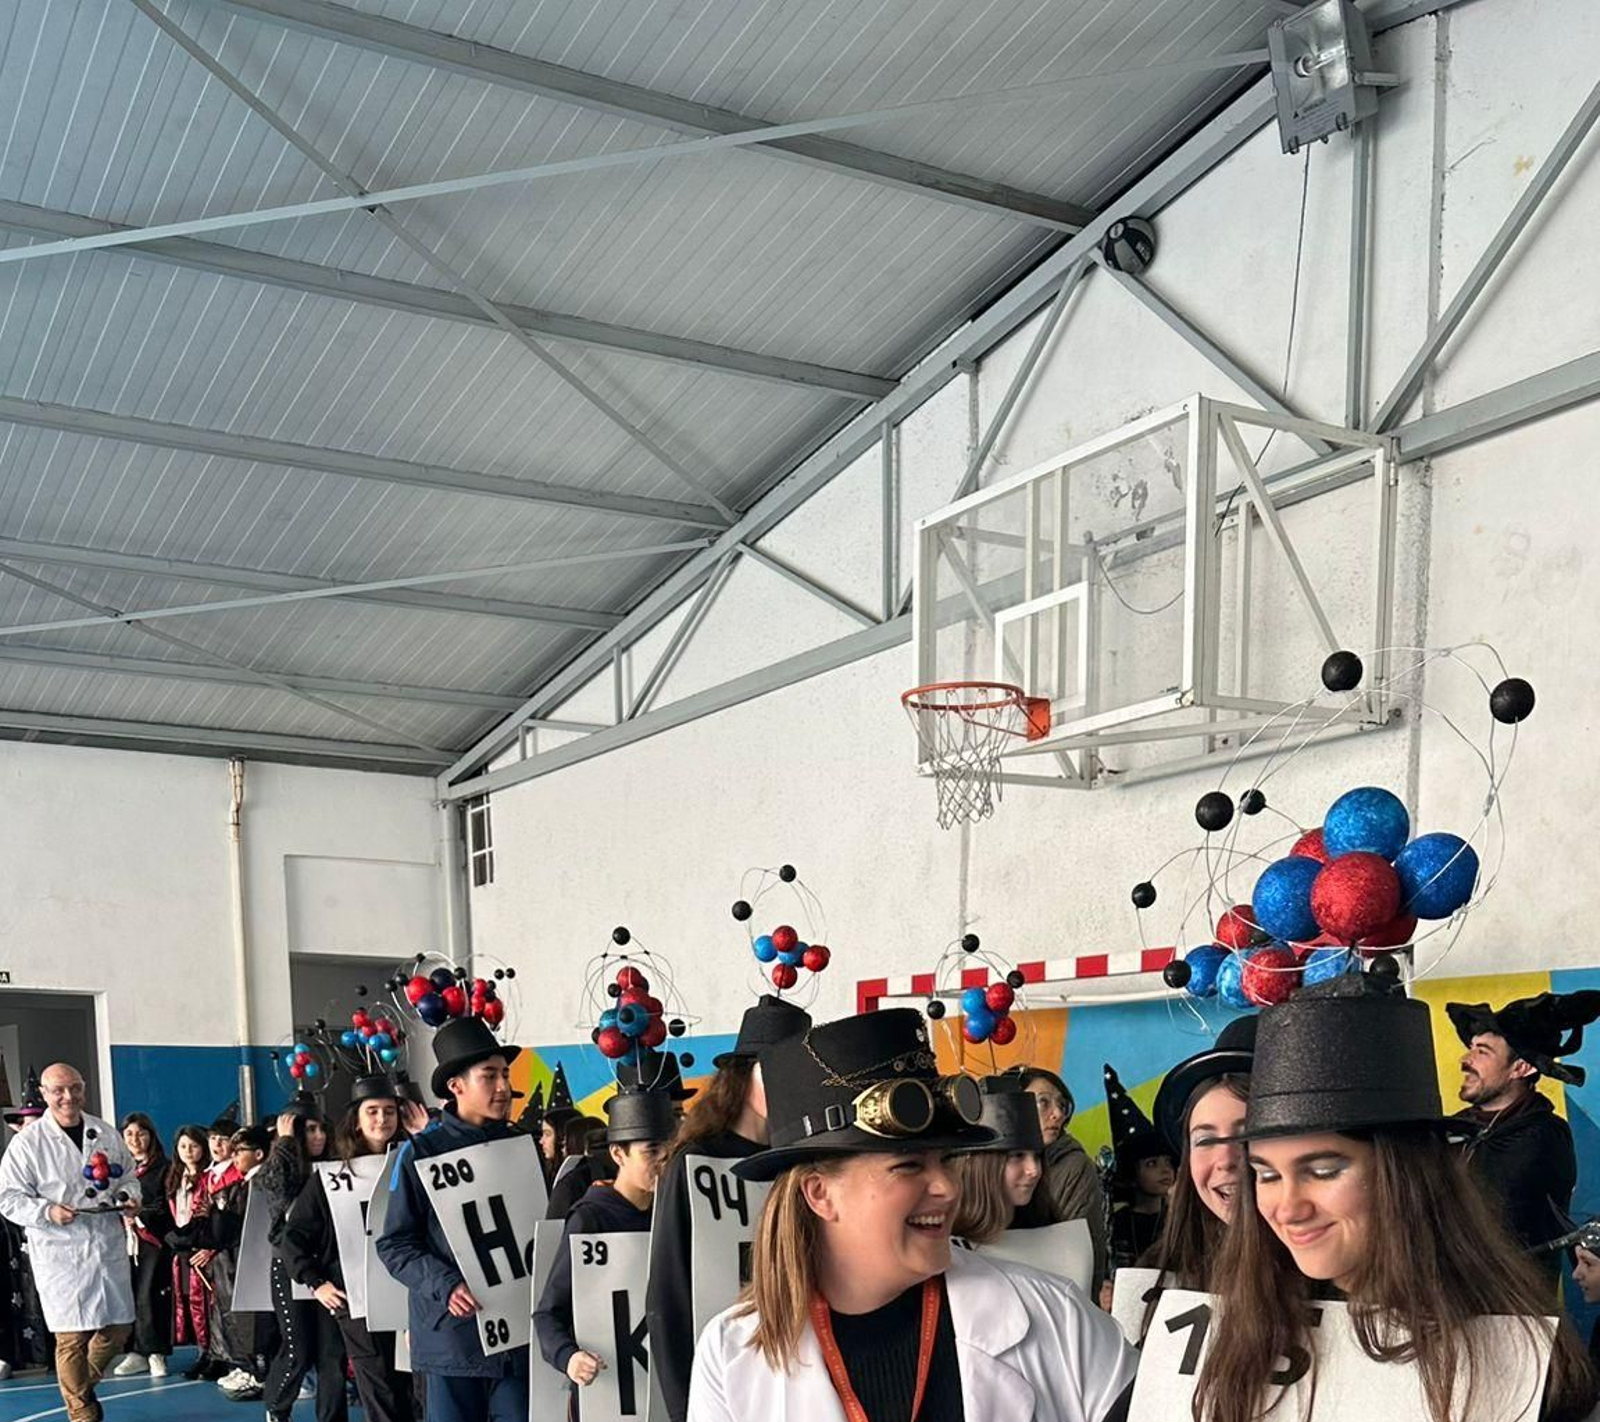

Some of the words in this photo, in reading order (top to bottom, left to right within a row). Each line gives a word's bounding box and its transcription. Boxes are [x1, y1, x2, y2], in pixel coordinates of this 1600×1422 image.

[429, 1158, 475, 1191] 200
[694, 1165, 749, 1227] 94
[581, 1240, 609, 1266] 39
[484, 1318, 510, 1348] 80
[1165, 1303, 1323, 1385] 15
